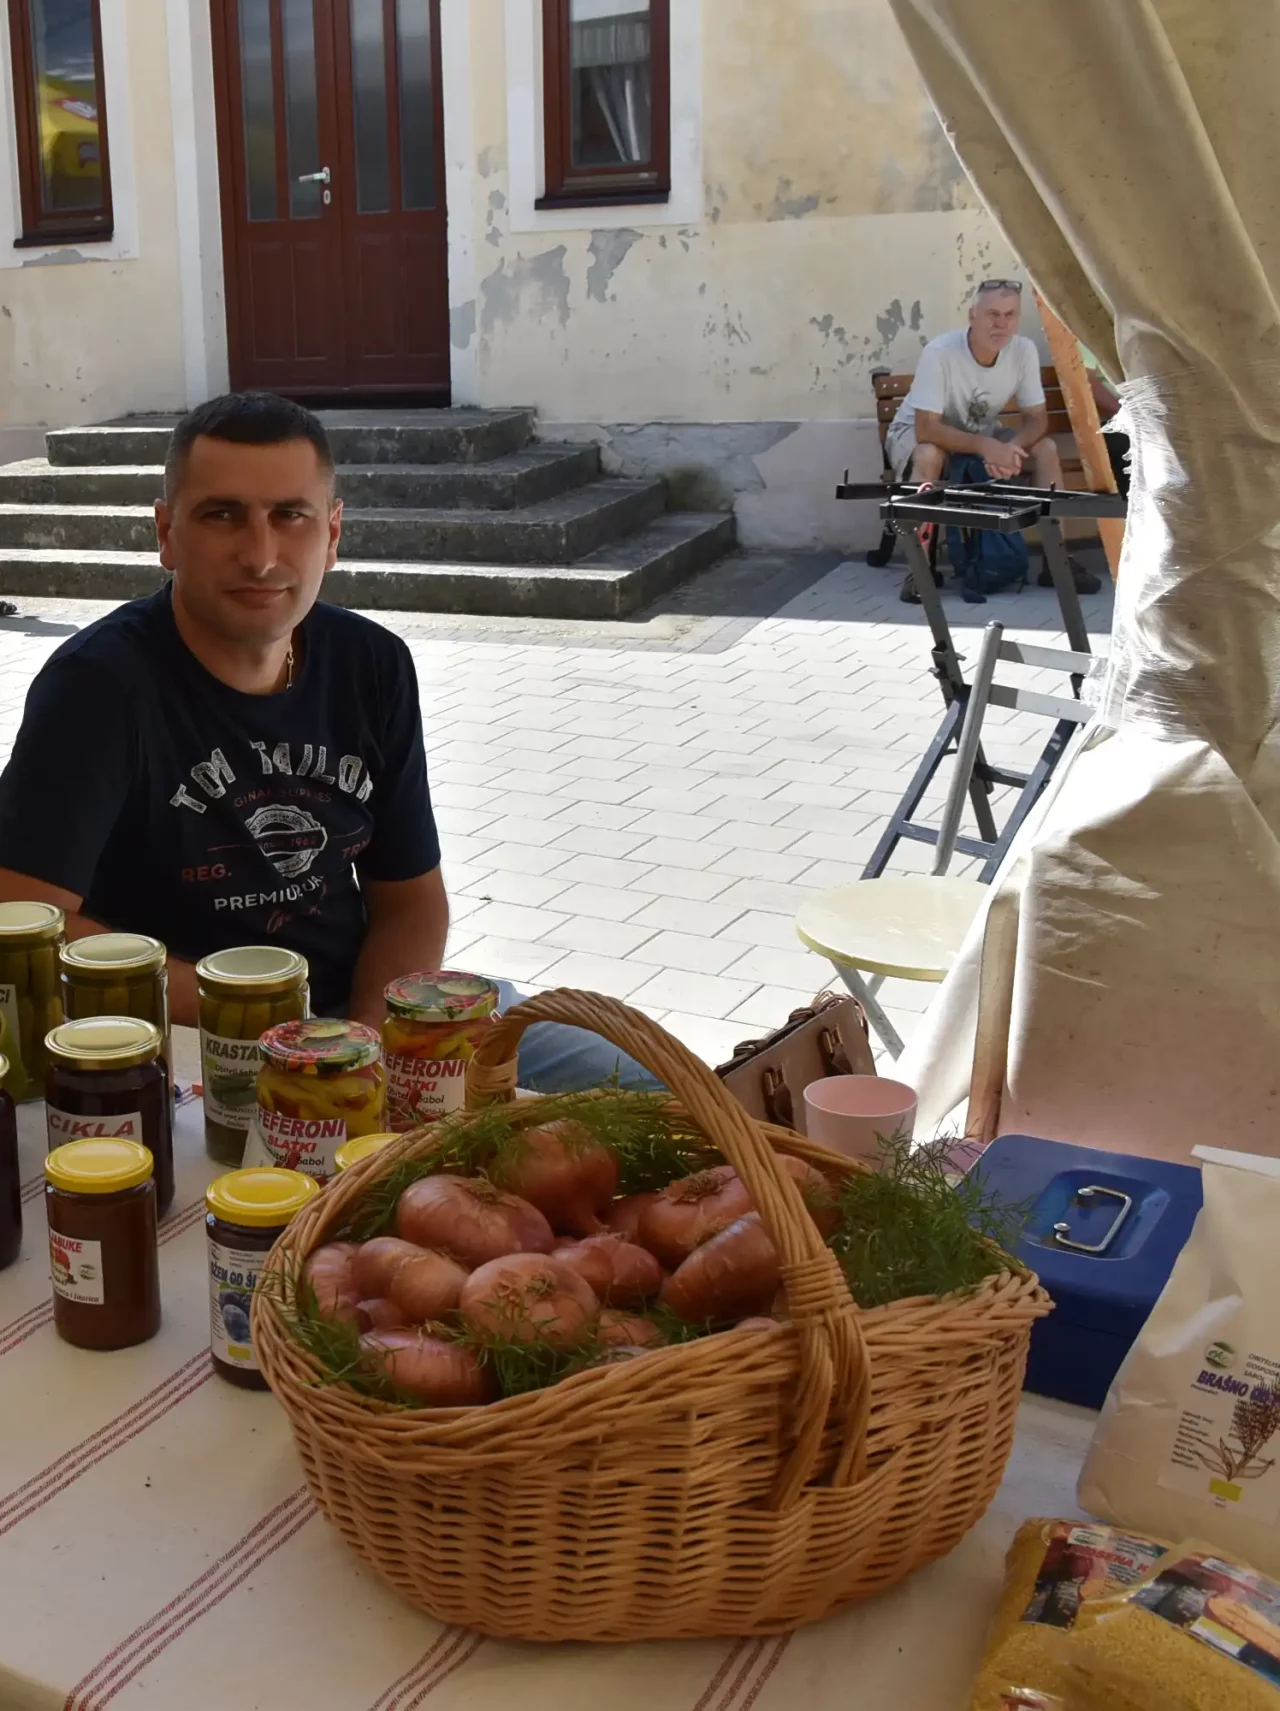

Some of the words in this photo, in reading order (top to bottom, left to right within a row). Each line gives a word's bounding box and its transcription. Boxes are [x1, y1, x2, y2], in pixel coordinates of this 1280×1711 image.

[170, 747, 236, 814] TOM
[182, 864, 232, 882] REG.
[390, 1074, 438, 1092] SLATKI
[50, 1114, 134, 1138] CIKLA
[267, 1134, 318, 1154] SLATKI
[229, 1271, 244, 1286] OD
[1197, 1369, 1250, 1397] BRAŠNO
